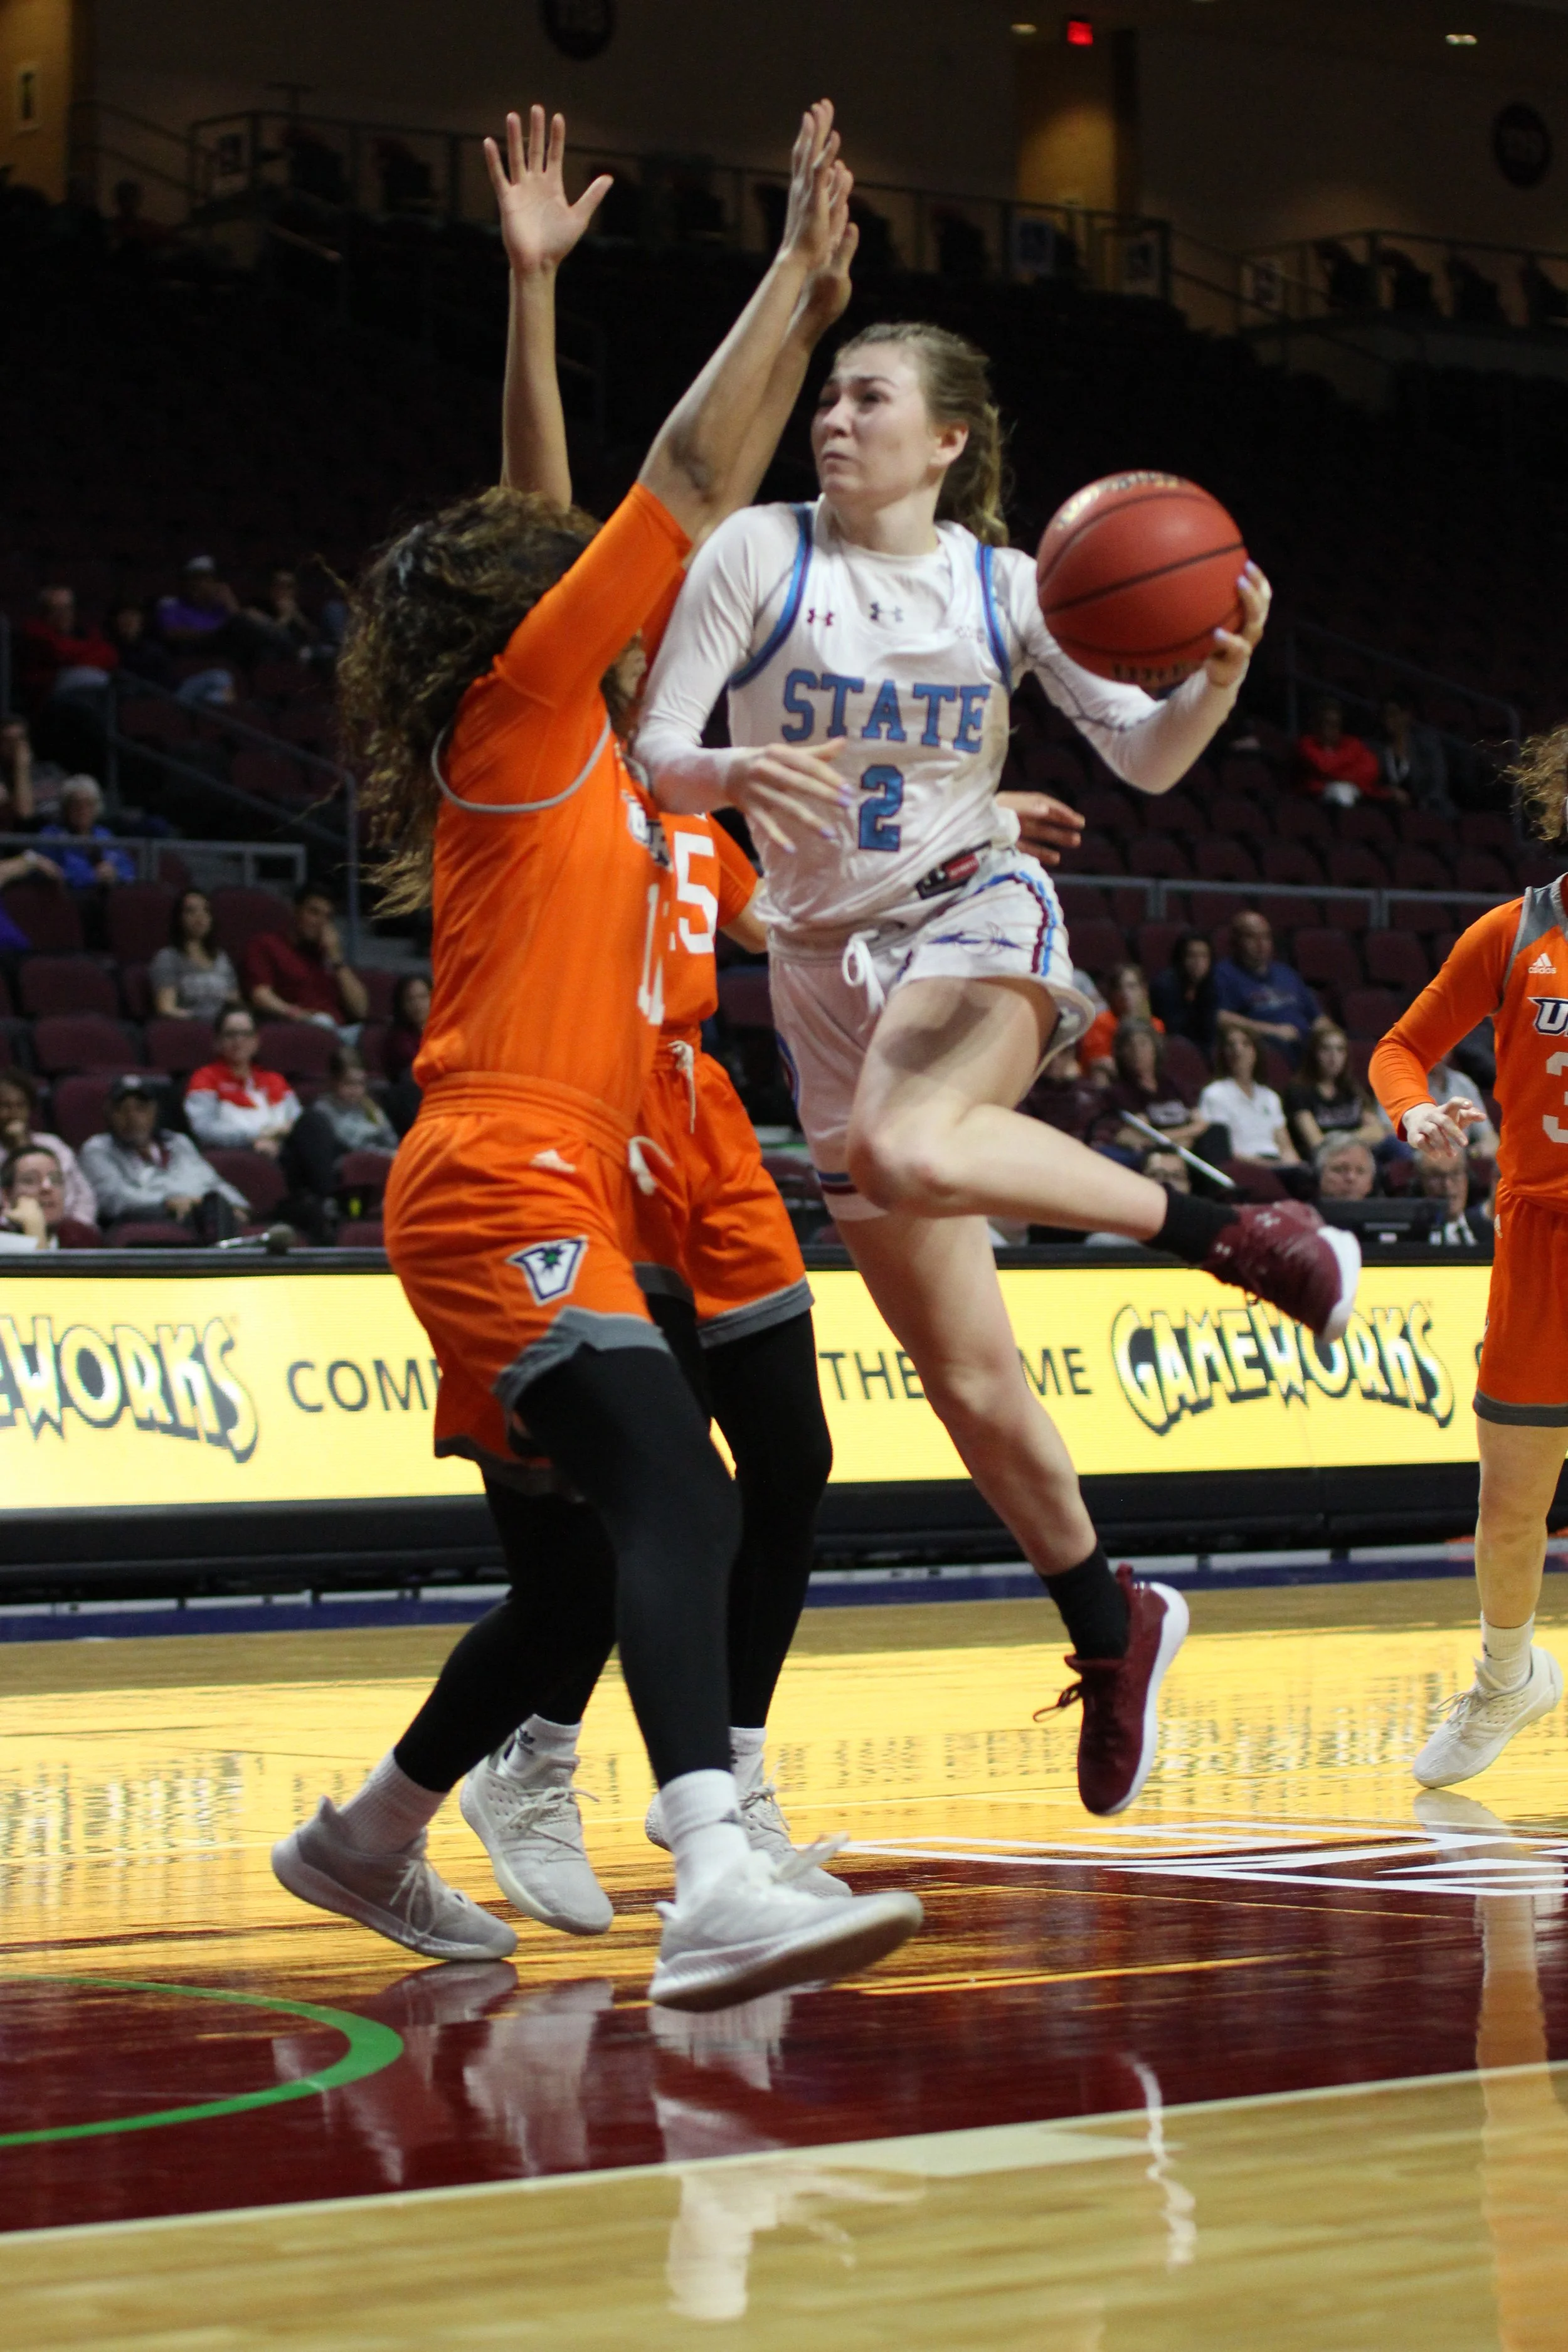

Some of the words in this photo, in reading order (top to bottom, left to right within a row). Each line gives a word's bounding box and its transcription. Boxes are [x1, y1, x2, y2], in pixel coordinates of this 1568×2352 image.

[781, 669, 992, 754] STATE
[858, 764, 904, 852] 2
[668, 830, 719, 955] 5
[0, 1313, 259, 1464] WORKS
[818, 1350, 926, 1401] THE
[1015, 1347, 1093, 1396] ME
[1111, 1301, 1455, 1436] GAMEWORKS
